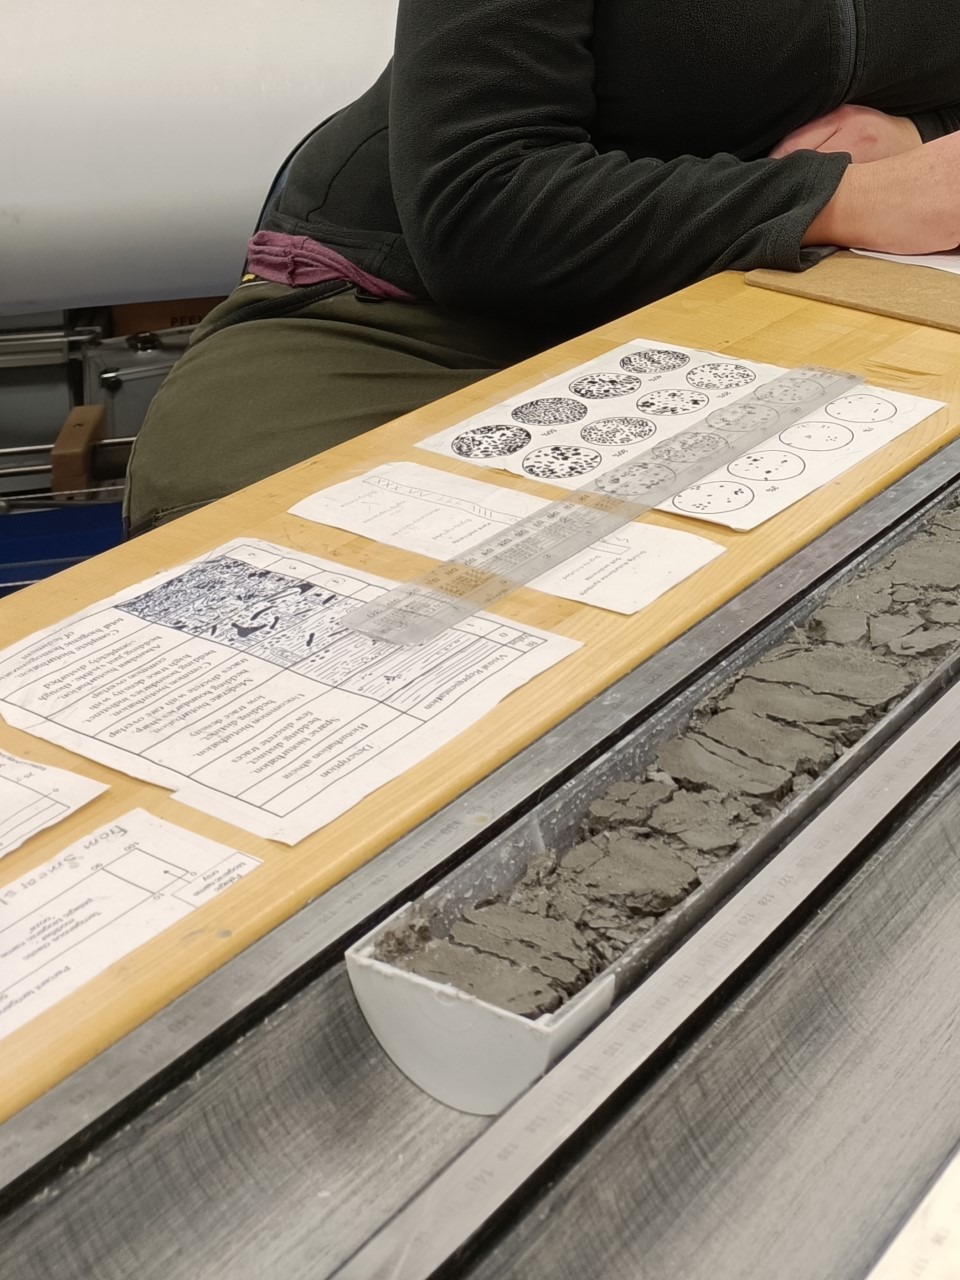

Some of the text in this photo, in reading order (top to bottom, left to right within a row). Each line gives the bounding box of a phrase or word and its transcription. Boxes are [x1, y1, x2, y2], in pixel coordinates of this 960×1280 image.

[64, 617, 124, 648] total biogenic
[74, 629, 120, 652] Complete
[118, 644, 161, 670] Abundant
[123, 635, 163, 657] bedding
[43, 640, 136, 689] completely disturbed
[106, 653, 124, 666] just
[178, 650, 216, 670] bedding
[89, 654, 192, 710] high trace density with
[91, 657, 167, 699] common overlap
[130, 670, 181, 697] boundaries
[169, 661, 212, 687] Common
[210, 669, 250, 691] bedding
[424, 653, 508, 710] Visual Representation
[38, 682, 72, 702] though
[108, 658, 248, 738] traces discrete with rare overlap
[209, 679, 253, 703] Moderate
[162, 690, 213, 718] boundaries
[223, 706, 247, 719] trace
[237, 700, 276, 721] bedding
[252, 694, 305, 724] Uncommon
[189, 719, 223, 737] density
[231, 711, 313, 763] few discrete traces
[283, 717, 322, 742] bedding
[309, 717, 340, 737] Sparse
[282, 723, 368, 779] Bioturbation absent
[320, 744, 373, 778] Description
[123, 841, 140, 852] 100
[90, 862, 103, 871] 90
[153, 892, 164, 900] 10
[713, 931, 737, 949] 130
